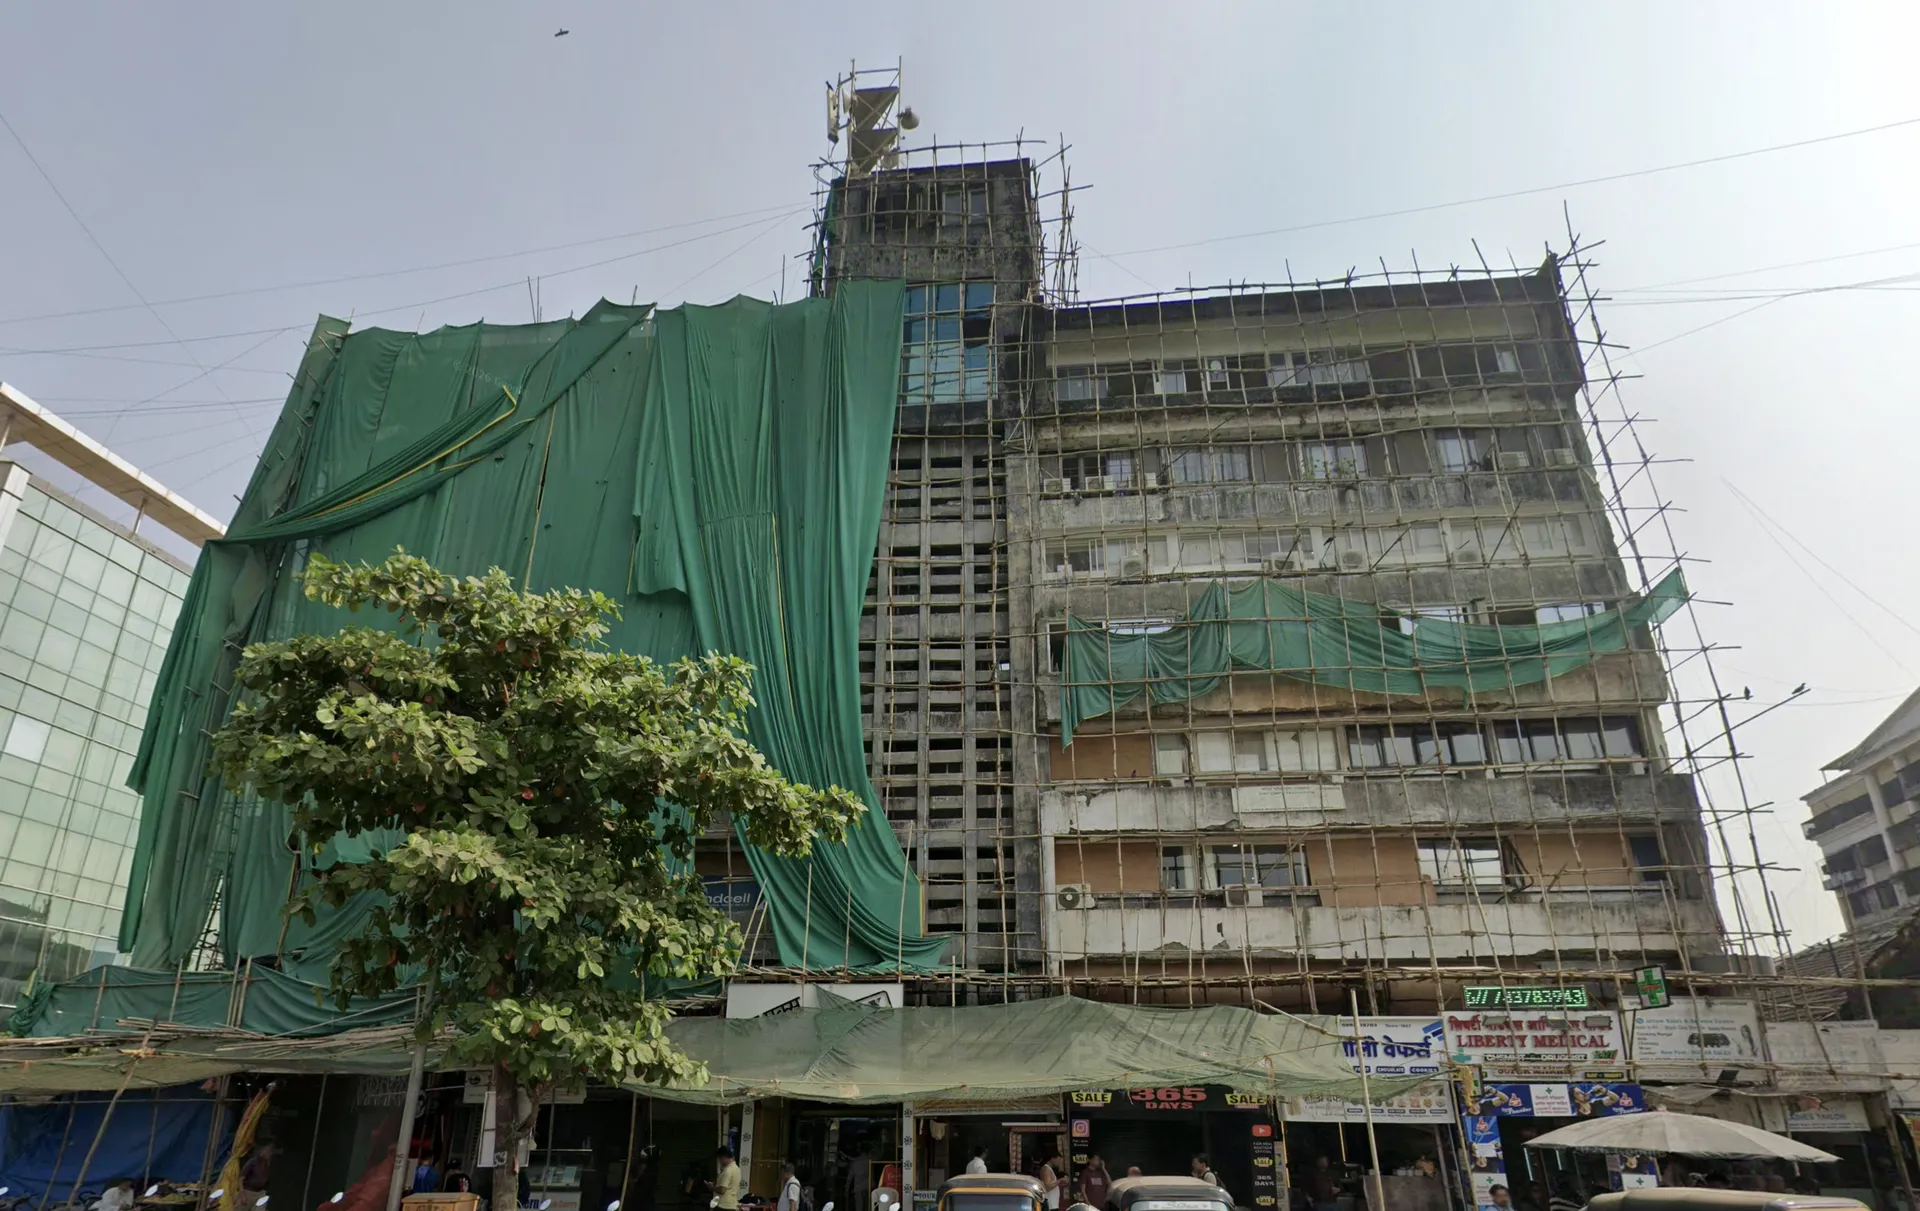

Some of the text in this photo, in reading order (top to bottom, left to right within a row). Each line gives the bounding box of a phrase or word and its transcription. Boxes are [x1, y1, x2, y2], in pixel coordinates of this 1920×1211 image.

[1074, 1092, 1110, 1103] SALE
[1130, 1087, 1207, 1102] 365
[1228, 1094, 1265, 1104] SALE
[1145, 1101, 1194, 1110] DAYS
